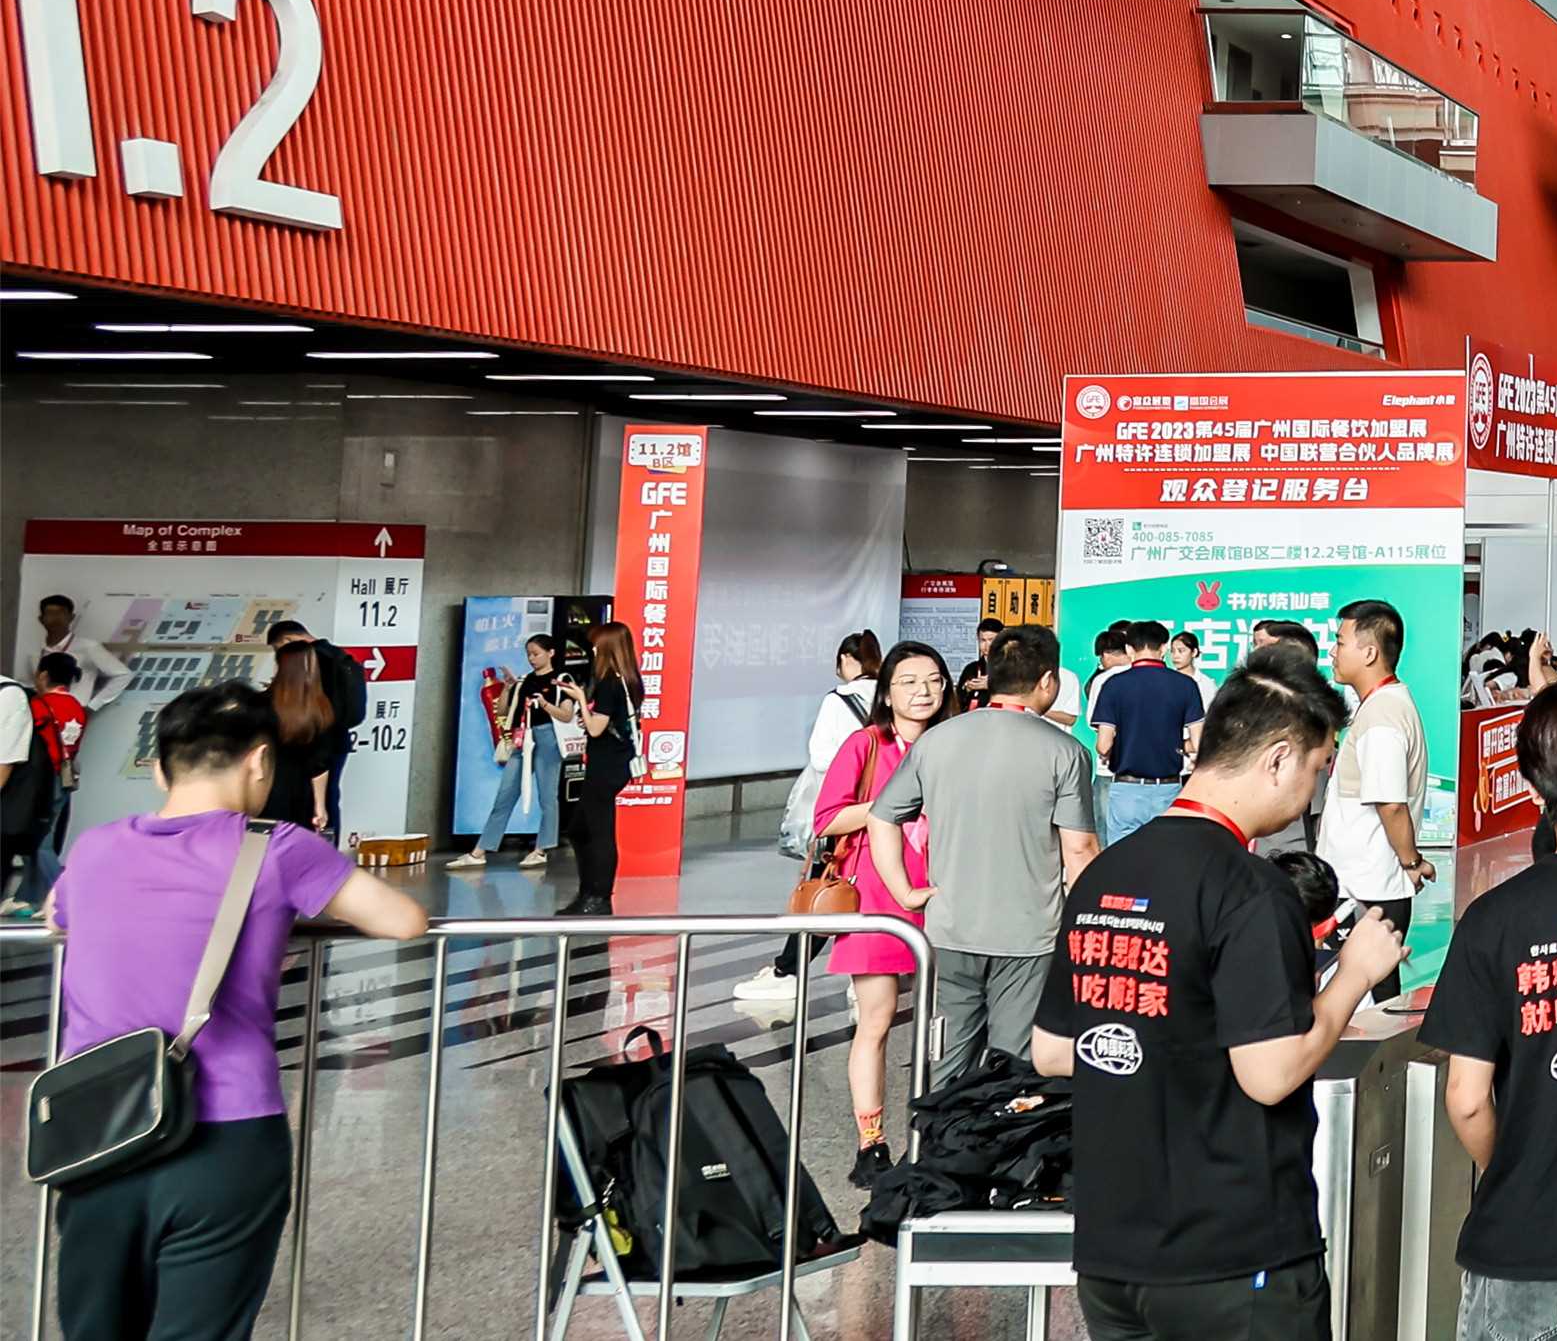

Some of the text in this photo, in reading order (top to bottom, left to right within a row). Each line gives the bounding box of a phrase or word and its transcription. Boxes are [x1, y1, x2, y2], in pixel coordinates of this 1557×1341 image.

[1381, 394, 1436, 407] Elephant
[1116, 418, 1428, 441] GFE 2023第45届广州国际餐饮加盟展
[637, 441, 693, 458] 11.2馆
[1075, 441, 1456, 464] 广州特许连锁加盟展 中国联营合伙人品牌展
[652, 456, 675, 469] B区
[640, 481, 688, 506] GFE
[1159, 477, 1370, 503] 观众登记服务台
[123, 524, 242, 539] Map of Complex
[1131, 530, 1215, 543] 400-085-7085
[351, 576, 409, 596] Hall 展厅
[1227, 592, 1331, 611] 书亦烧仙草
[359, 600, 398, 628] 11.2
[375, 700, 401, 720] 展厅
